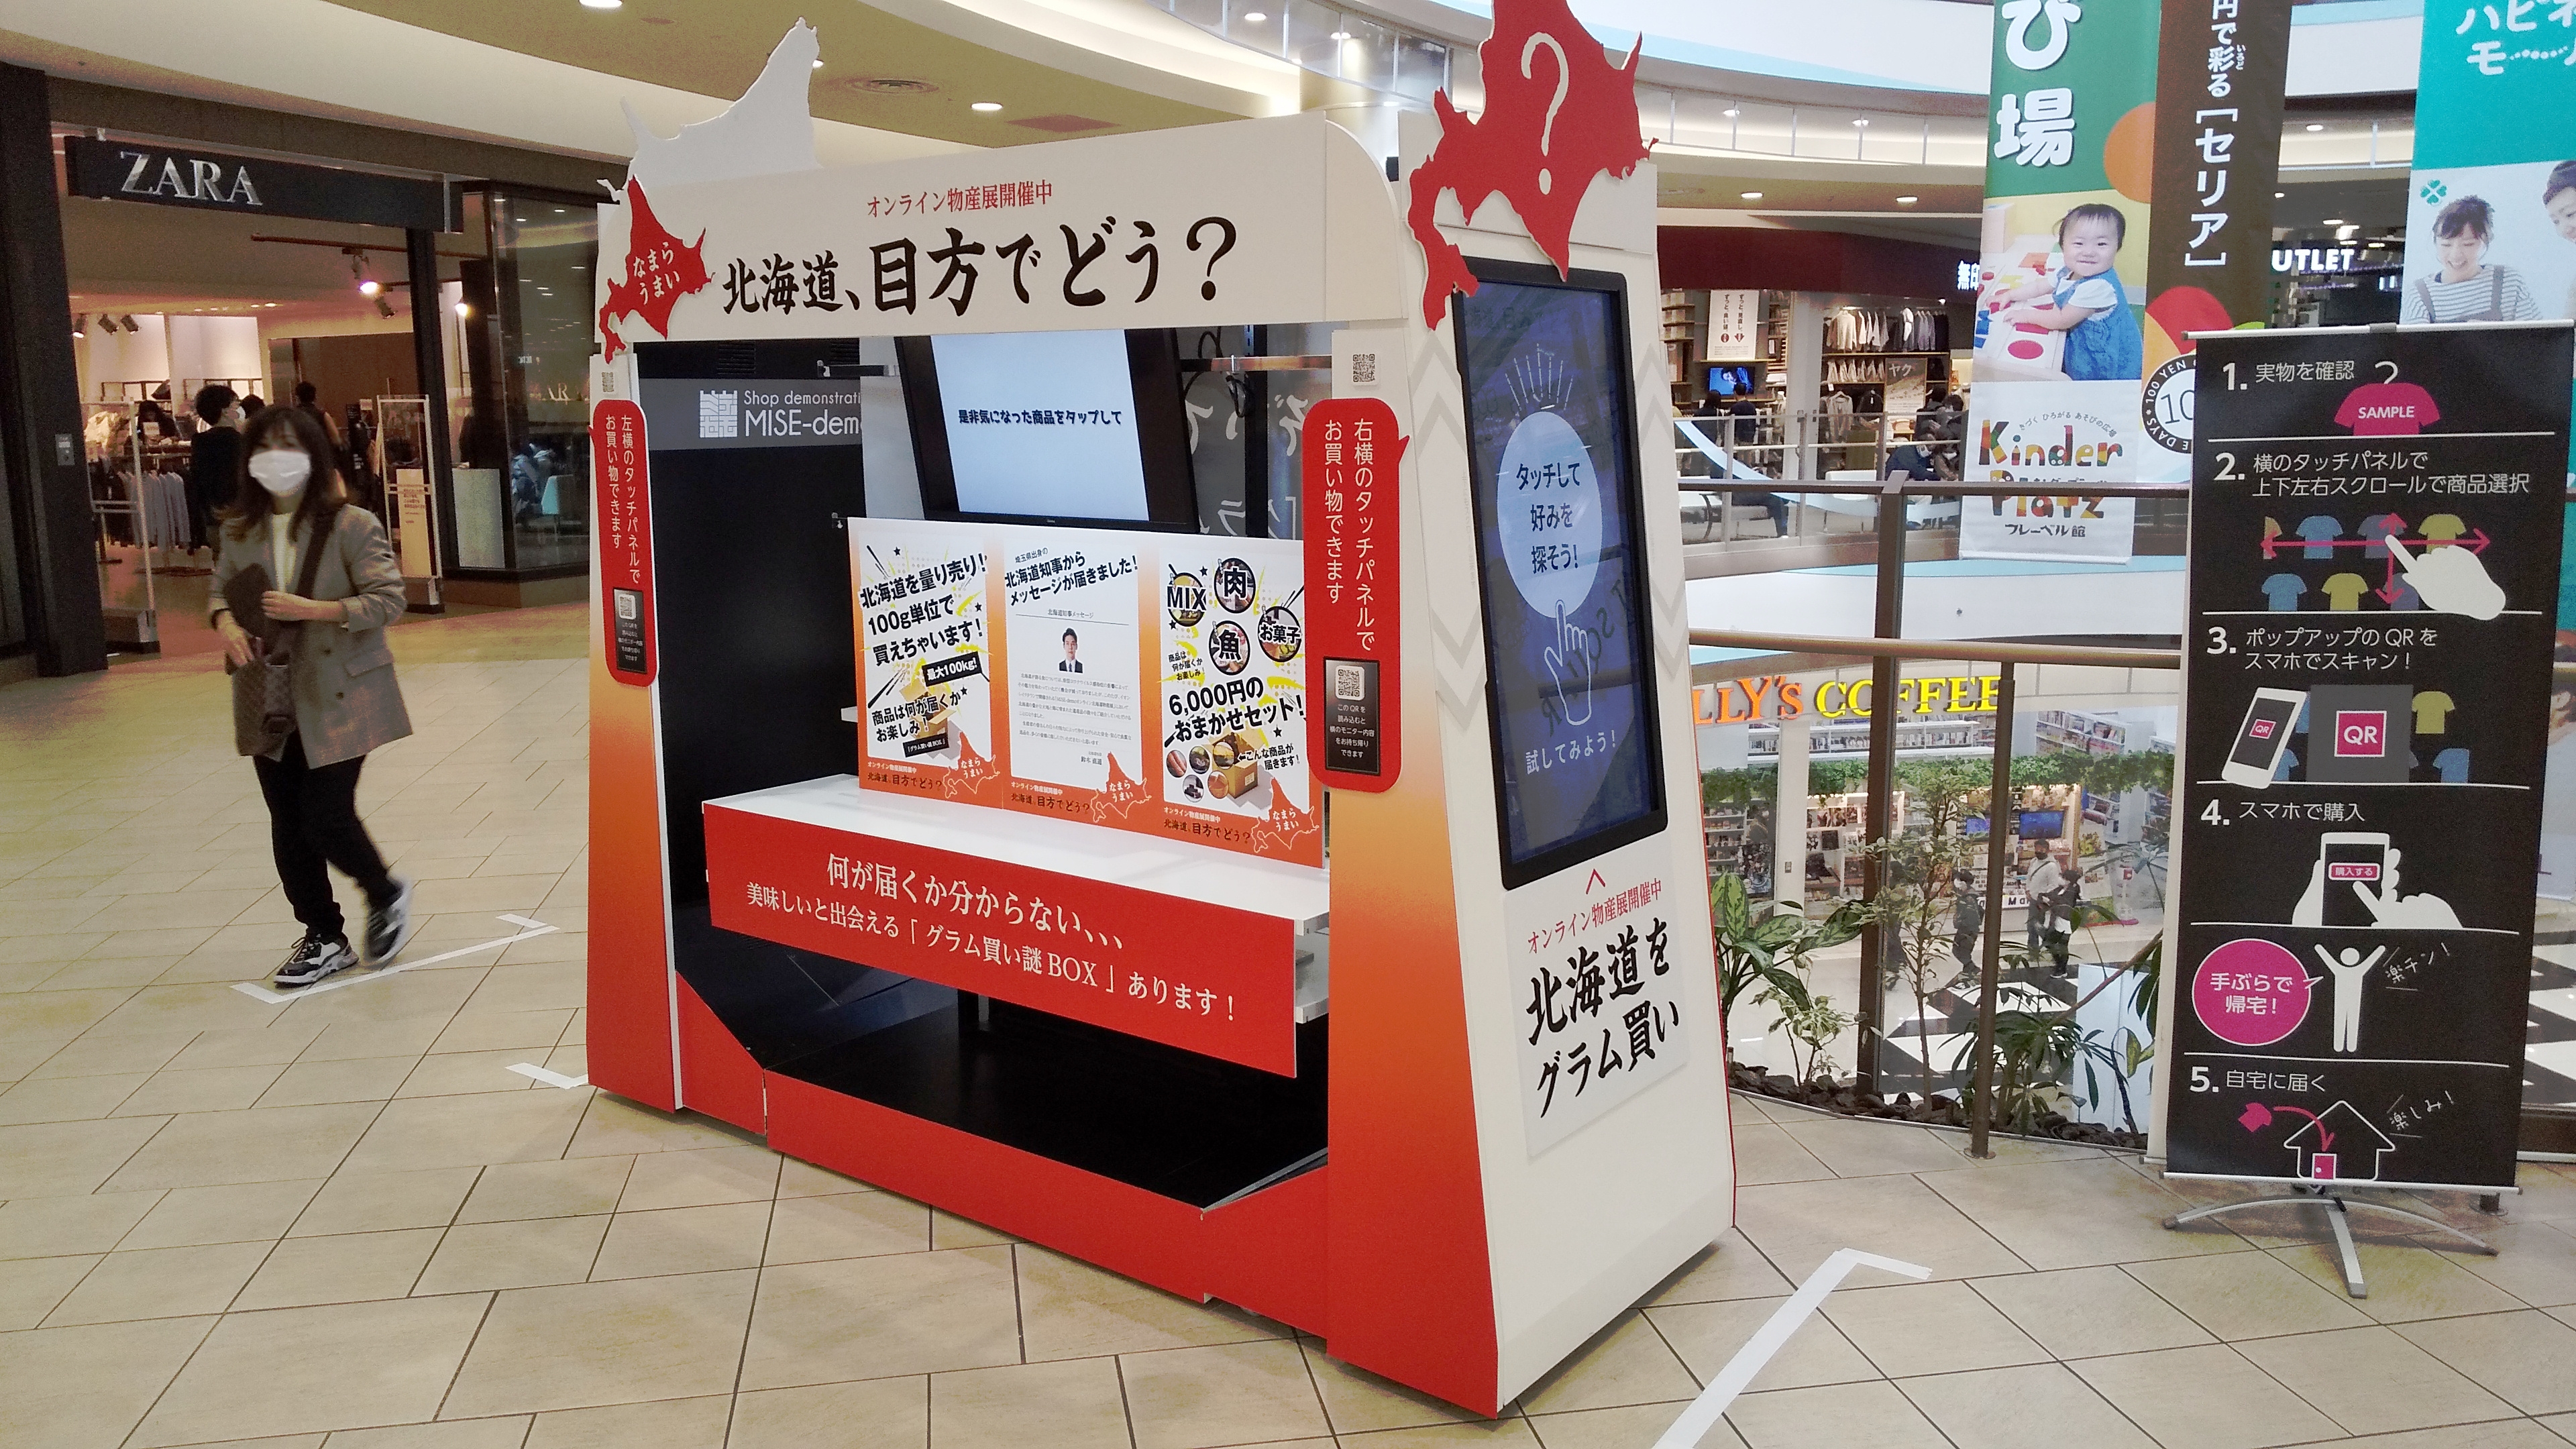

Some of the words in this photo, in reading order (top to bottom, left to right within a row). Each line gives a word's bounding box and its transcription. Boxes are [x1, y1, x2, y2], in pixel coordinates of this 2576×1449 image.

[120, 151, 262, 205] ZARA
[867, 180, 1053, 218] オンライン物産展開催中
[633, 241, 675, 277] なまら
[722, 215, 1237, 316] 北海道、目方でどう？
[639, 272, 681, 306] うまい
[2145, 381, 2160, 403] 100
[2159, 360, 2186, 378] YEN
[2222, 362, 2247, 390] 1.
[2255, 360, 2355, 383] 実物を確認
[744, 390, 779, 407] Shop
[2358, 405, 2415, 419] SAMPLE
[745, 409, 862, 437] MISE-dem
[959, 409, 1122, 425] 是非気になった商品をタップして
[2147, 417, 2177, 447] DAYS
[1978, 419, 2123, 466] Kinder
[1516, 462, 1581, 491] タッチして
[2213, 452, 2245, 481] 2.
[2253, 450, 2428, 474] 横のタッチパネルで
[605, 415, 622, 549] お買い物できます
[2252, 473, 2530, 497] 上下左右スクロールで商品選択
[621, 415, 641, 584] 左横のタッチパネルで
[1325, 420, 1344, 604] お買い物できます
[1530, 502, 1573, 532] 好みを
[2004, 523, 2086, 537] フレーベル館
[1354, 418, 1375, 651] 右横のタッチパネルで
[1005, 551, 1085, 588] 北海道知事から
[1015, 547, 1048, 564] 埼玉県出身の
[1531, 543, 1578, 574] 探そう！
[860, 553, 986, 608] 北海道を量り売り！
[1011, 555, 1138, 606] メッセージが届きました！
[1224, 568, 1246, 598] 肉
[1167, 585, 1206, 611] MIX
[868, 594, 955, 635] 100g単位で
[873, 618, 983, 666] 買えちゃいます！
[1219, 629, 1241, 661] 魚
[1260, 624, 1301, 645] お菓子
[2206, 627, 2237, 654] 3.
[1169, 651, 1187, 663] 商品は
[2245, 653, 2411, 671] スマホでスキャン！
[871, 691, 961, 727] 商品は何が届くか
[1169, 676, 1264, 716] 6,000円の
[876, 718, 928, 743] お楽しみ！
[1175, 694, 1304, 742] おまかせセット！
[2254, 724, 2270, 736] QR
[2343, 725, 2377, 746] QR
[961, 757, 981, 768] なまら
[1246, 743, 1293, 760] こんな商品が
[1340, 749, 1364, 758] できます
[1525, 729, 1616, 775] 試してみよう！
[963, 768, 983, 779] うまい
[1109, 780, 1130, 792] なまら
[1112, 791, 1133, 802] うまい
[1273, 808, 1297, 820] なまら
[1275, 820, 1299, 833] うまい
[2200, 799, 2230, 826] 4.
[2239, 801, 2365, 822] スマホで購入
[2334, 866, 2373, 877] 購入する
[1527, 877, 1662, 954] オンライン物産展開催中
[1526, 917, 1670, 1046] 北海道を
[2210, 972, 2293, 992] 手ぶらで
[2225, 996, 2277, 1014] 帰宅！
[1536, 1000, 1679, 1119] グラム買い
[2190, 1066, 2219, 1093] 5.
[2226, 1071, 2326, 1093] 自宅に届く
